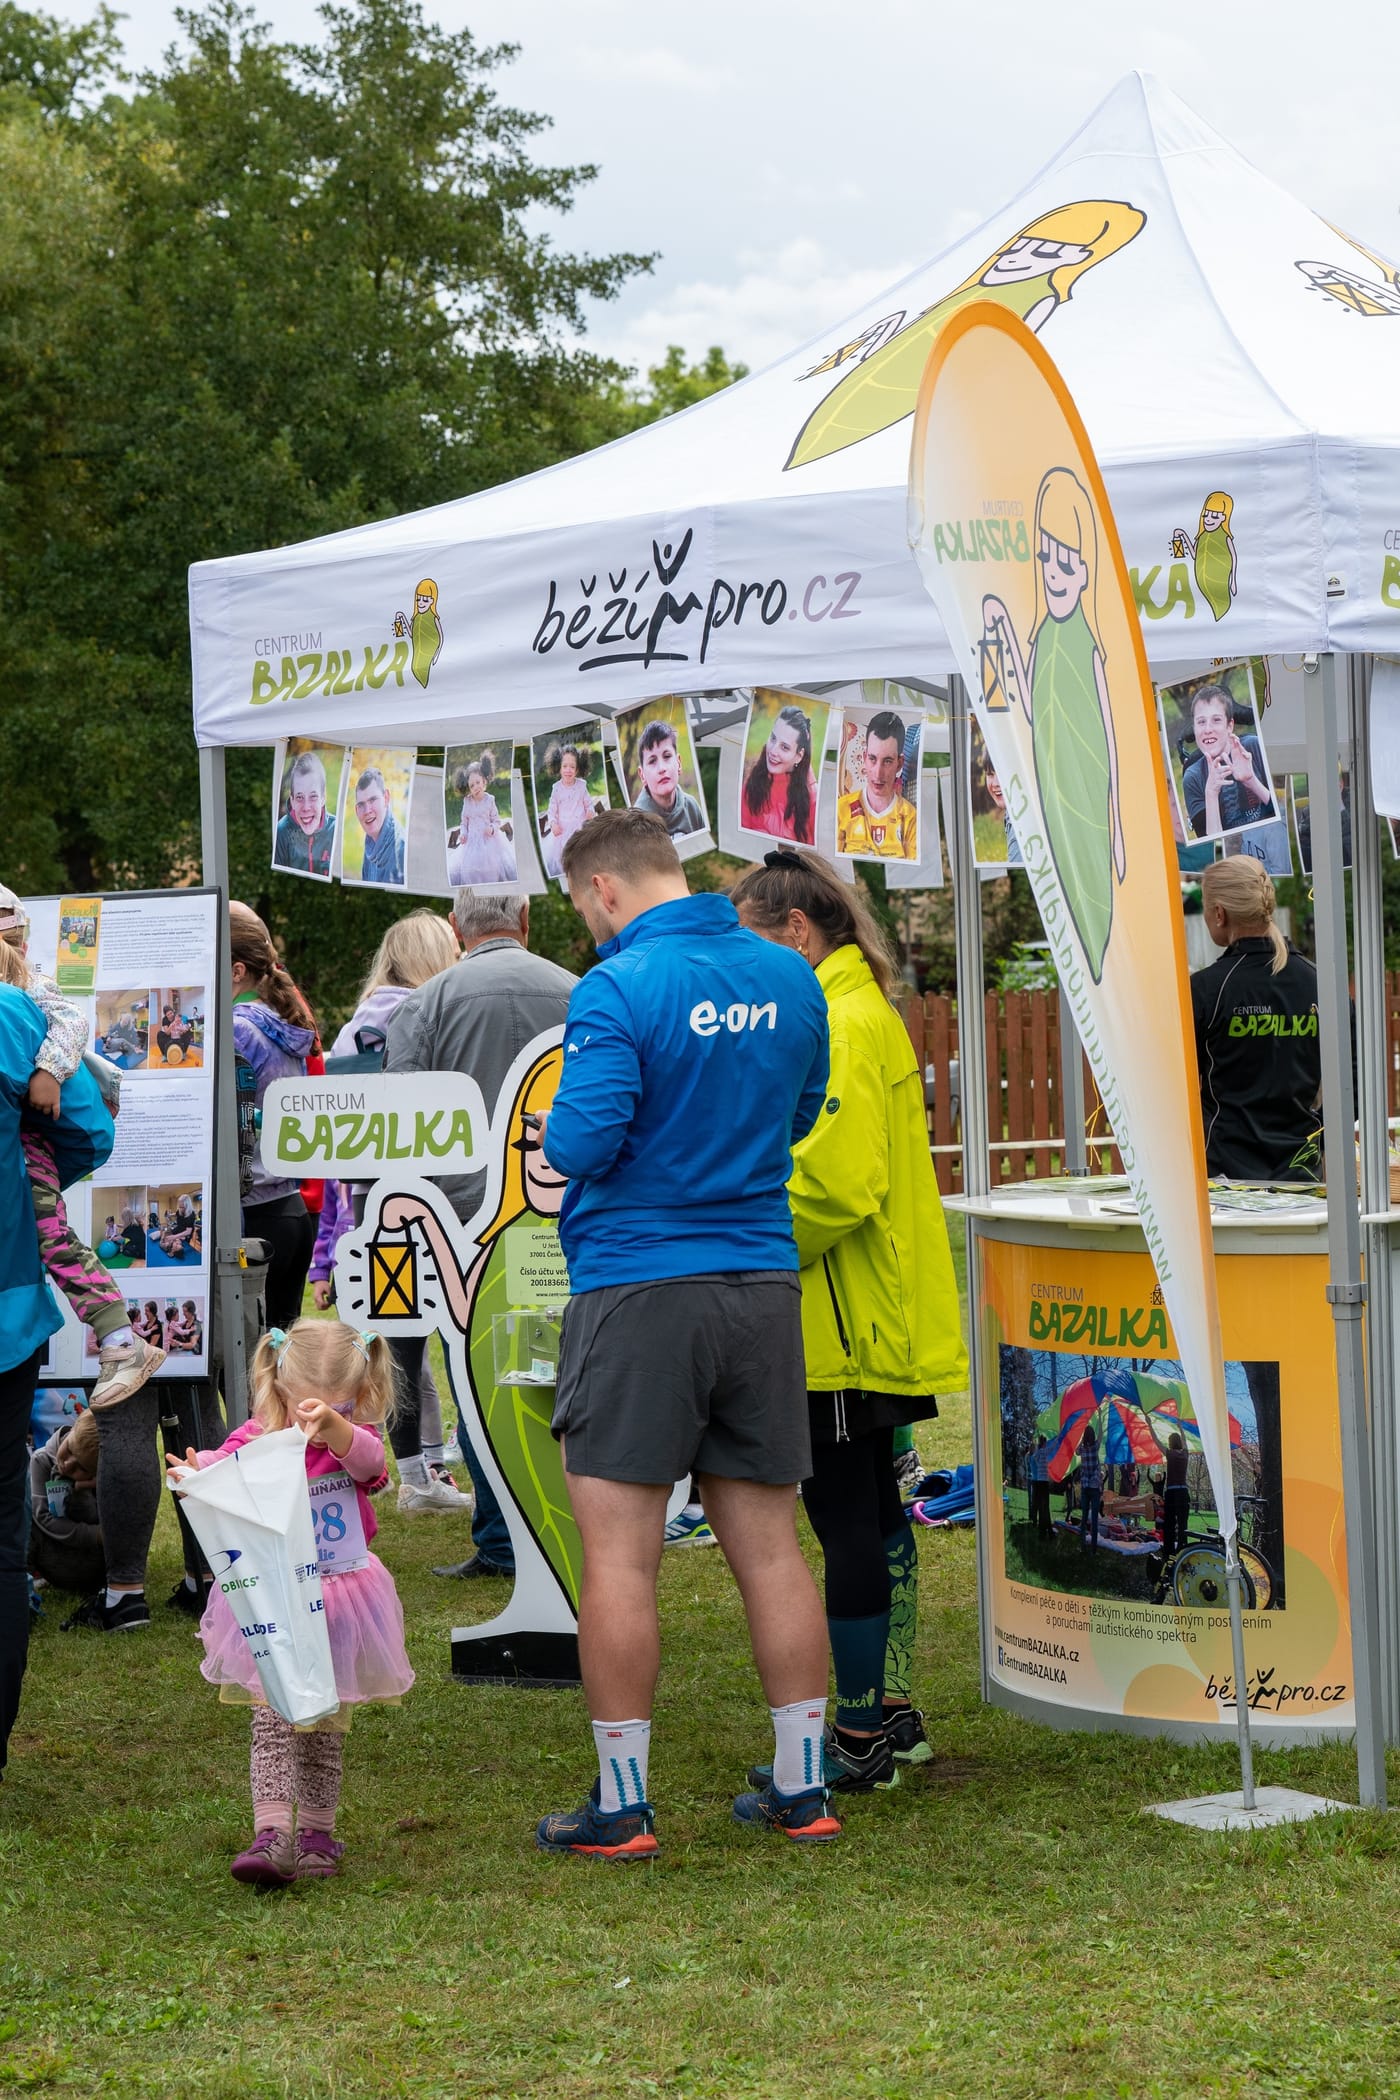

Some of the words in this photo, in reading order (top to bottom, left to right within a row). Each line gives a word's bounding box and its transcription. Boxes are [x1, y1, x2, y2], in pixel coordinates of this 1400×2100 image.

[1383, 529, 1400, 550] CE
[1129, 562, 1196, 620] KA
[254, 631, 322, 656] CENTRUM
[249, 640, 409, 705] BAZALKA
[1233, 1005, 1272, 1015] CENTRUM
[1228, 1014, 1318, 1037] BAZALKA
[280, 1093, 365, 1112] CENTRUM
[277, 1109, 473, 1162] BAZALKA
[520, 1267, 537, 1276] Číslo
[539, 1268, 554, 1276] účtu
[556, 1268, 569, 1276] veř
[530, 1279, 569, 1287] 200183662
[1031, 1283, 1084, 1302] CENTRUM
[1029, 1300, 1167, 1349] BAZALKA
[309, 1478, 352, 1497] UŇÁKU
[1010, 1586, 1039, 1606] Komplexní
[1040, 1597, 1056, 1610] péče
[1057, 1601, 1063, 1611] o
[1064, 1601, 1080, 1614] děti
[1082, 1604, 1087, 1616] s
[1089, 1604, 1121, 1622] těžkým
[1124, 1608, 1204, 1629] kombinovaným
[1208, 1615, 1272, 1630] postením
[1046, 1614, 1051, 1625] a
[1052, 1614, 1093, 1633] poruchami
[1096, 1622, 1154, 1640] autistického
[1157, 1629, 1197, 1644] spektra
[995, 1626, 1080, 1663] www.centrumBAZALKA.cz
[1003, 1652, 1067, 1685] CentrumBAZALKA
[1205, 1667, 1346, 1711] běímpro.cz
